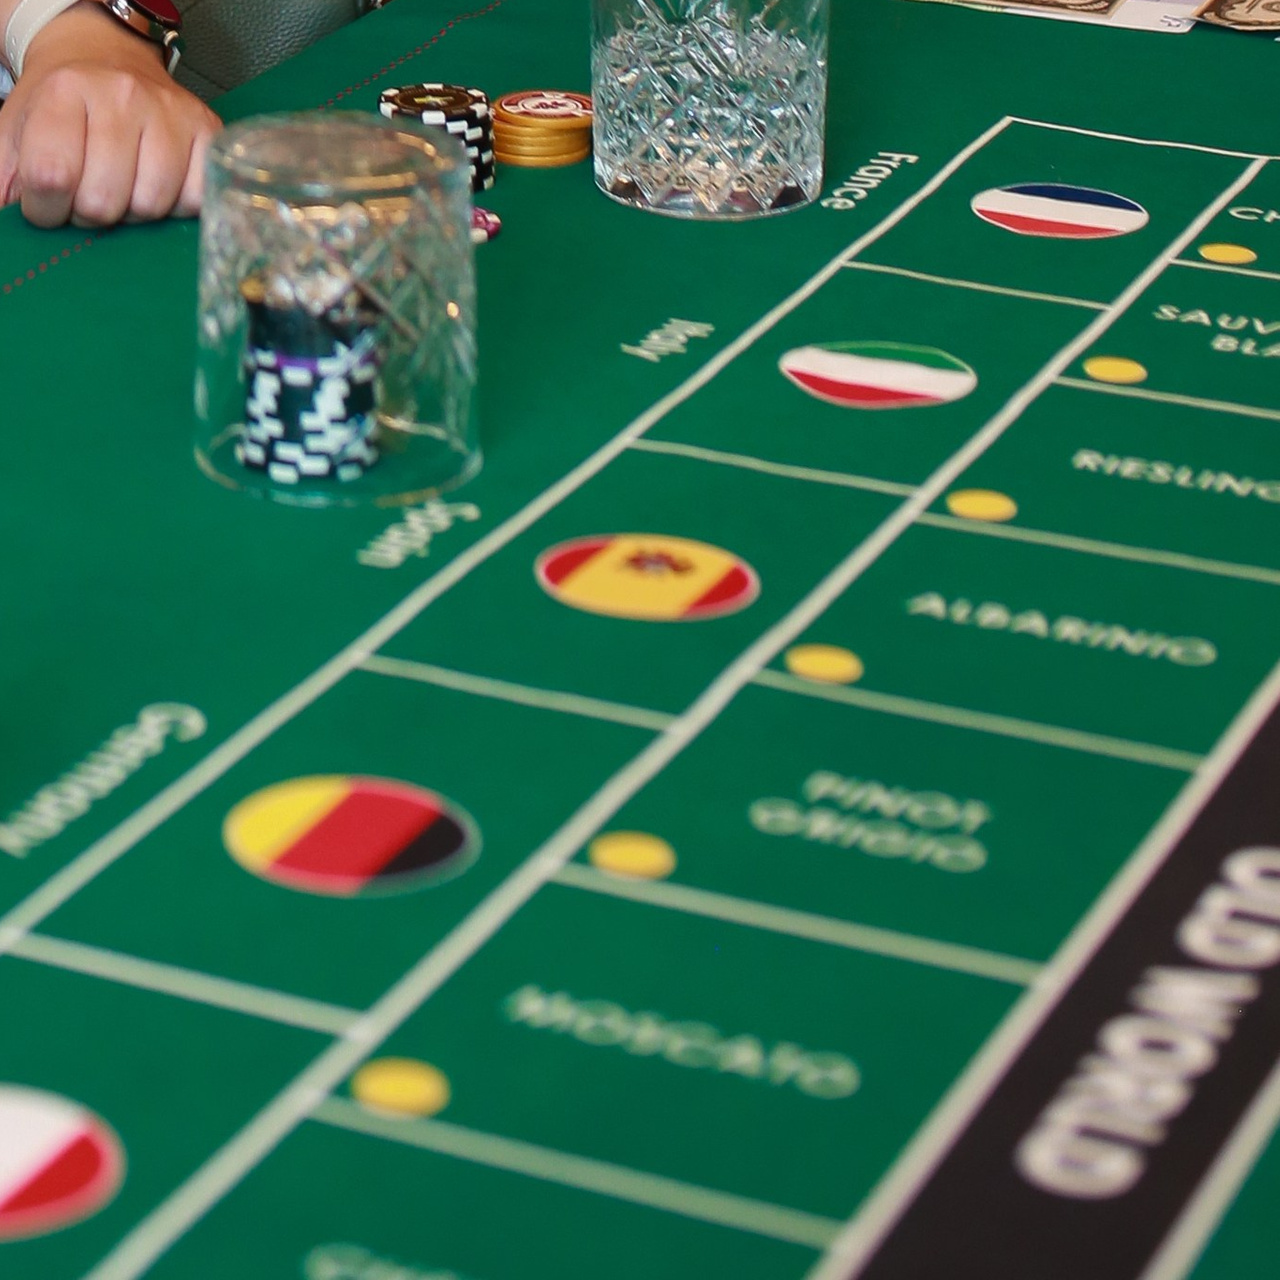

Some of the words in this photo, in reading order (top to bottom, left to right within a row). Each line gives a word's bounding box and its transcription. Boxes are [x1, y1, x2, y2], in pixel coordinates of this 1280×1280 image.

[820, 151, 919, 211] France
[748, 795, 989, 874] GRIGIO
[802, 769, 993, 835] PINOT
[504, 983, 862, 1101] MOSCATO
[1014, 963, 1261, 1201] WORLD
